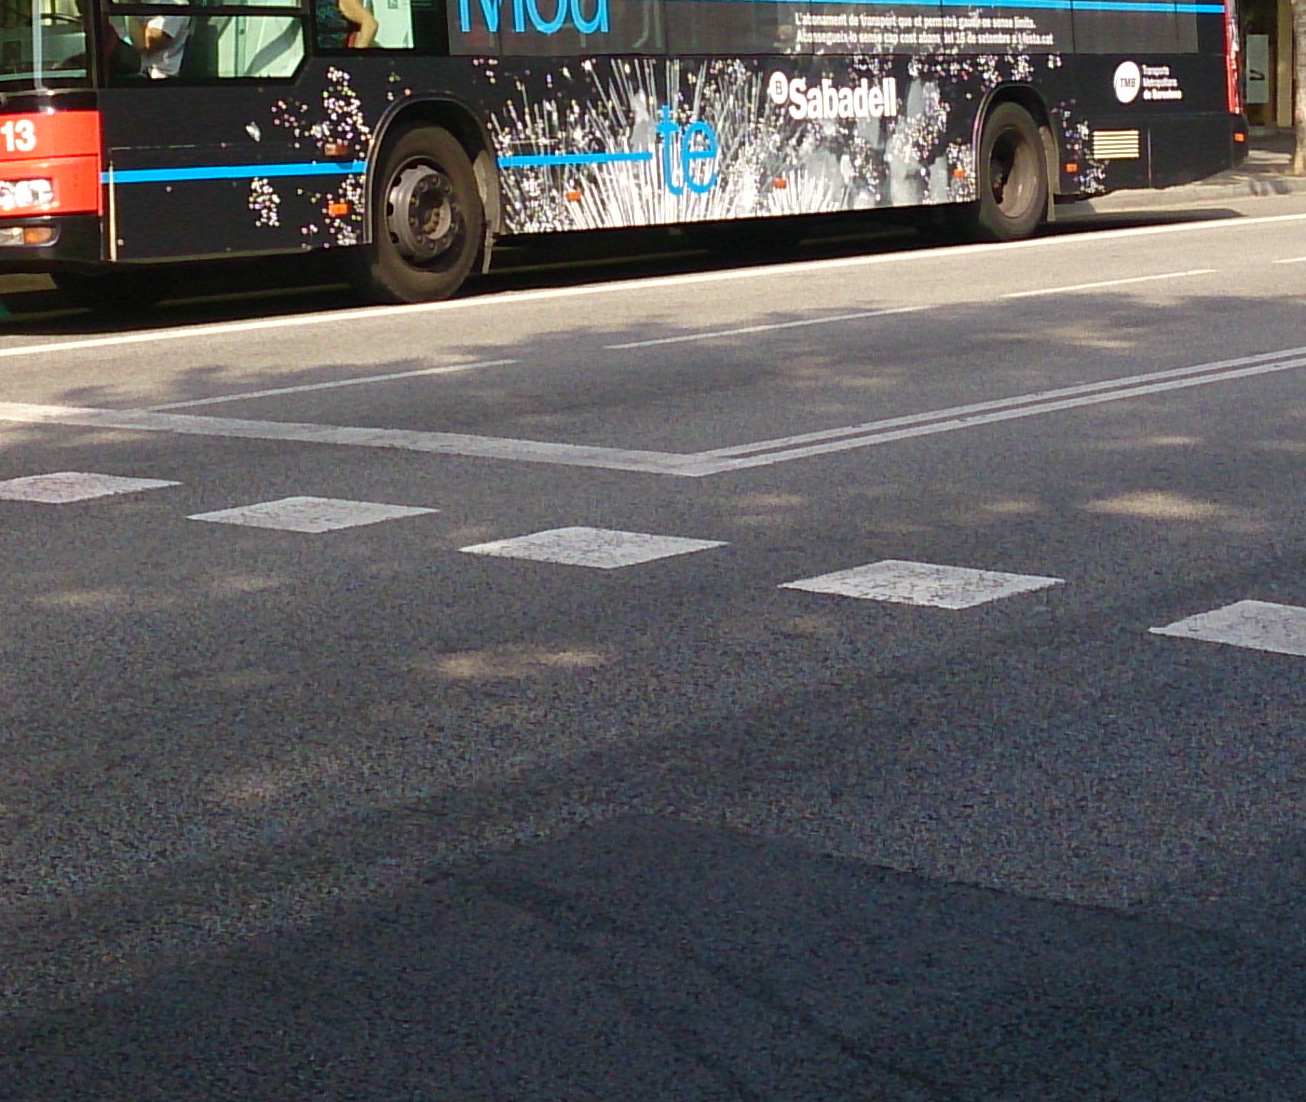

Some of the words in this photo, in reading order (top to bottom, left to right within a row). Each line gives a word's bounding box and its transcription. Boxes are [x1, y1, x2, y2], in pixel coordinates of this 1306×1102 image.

[848, 13, 859, 26] de
[860, 13, 897, 28] transport
[898, 15, 912, 29] que
[913, 15, 922, 27] et
[859, 32, 882, 43] sense
[899, 31, 917, 43] cost
[788, 77, 897, 120] Sabadell
[656, 105, 718, 196] te
